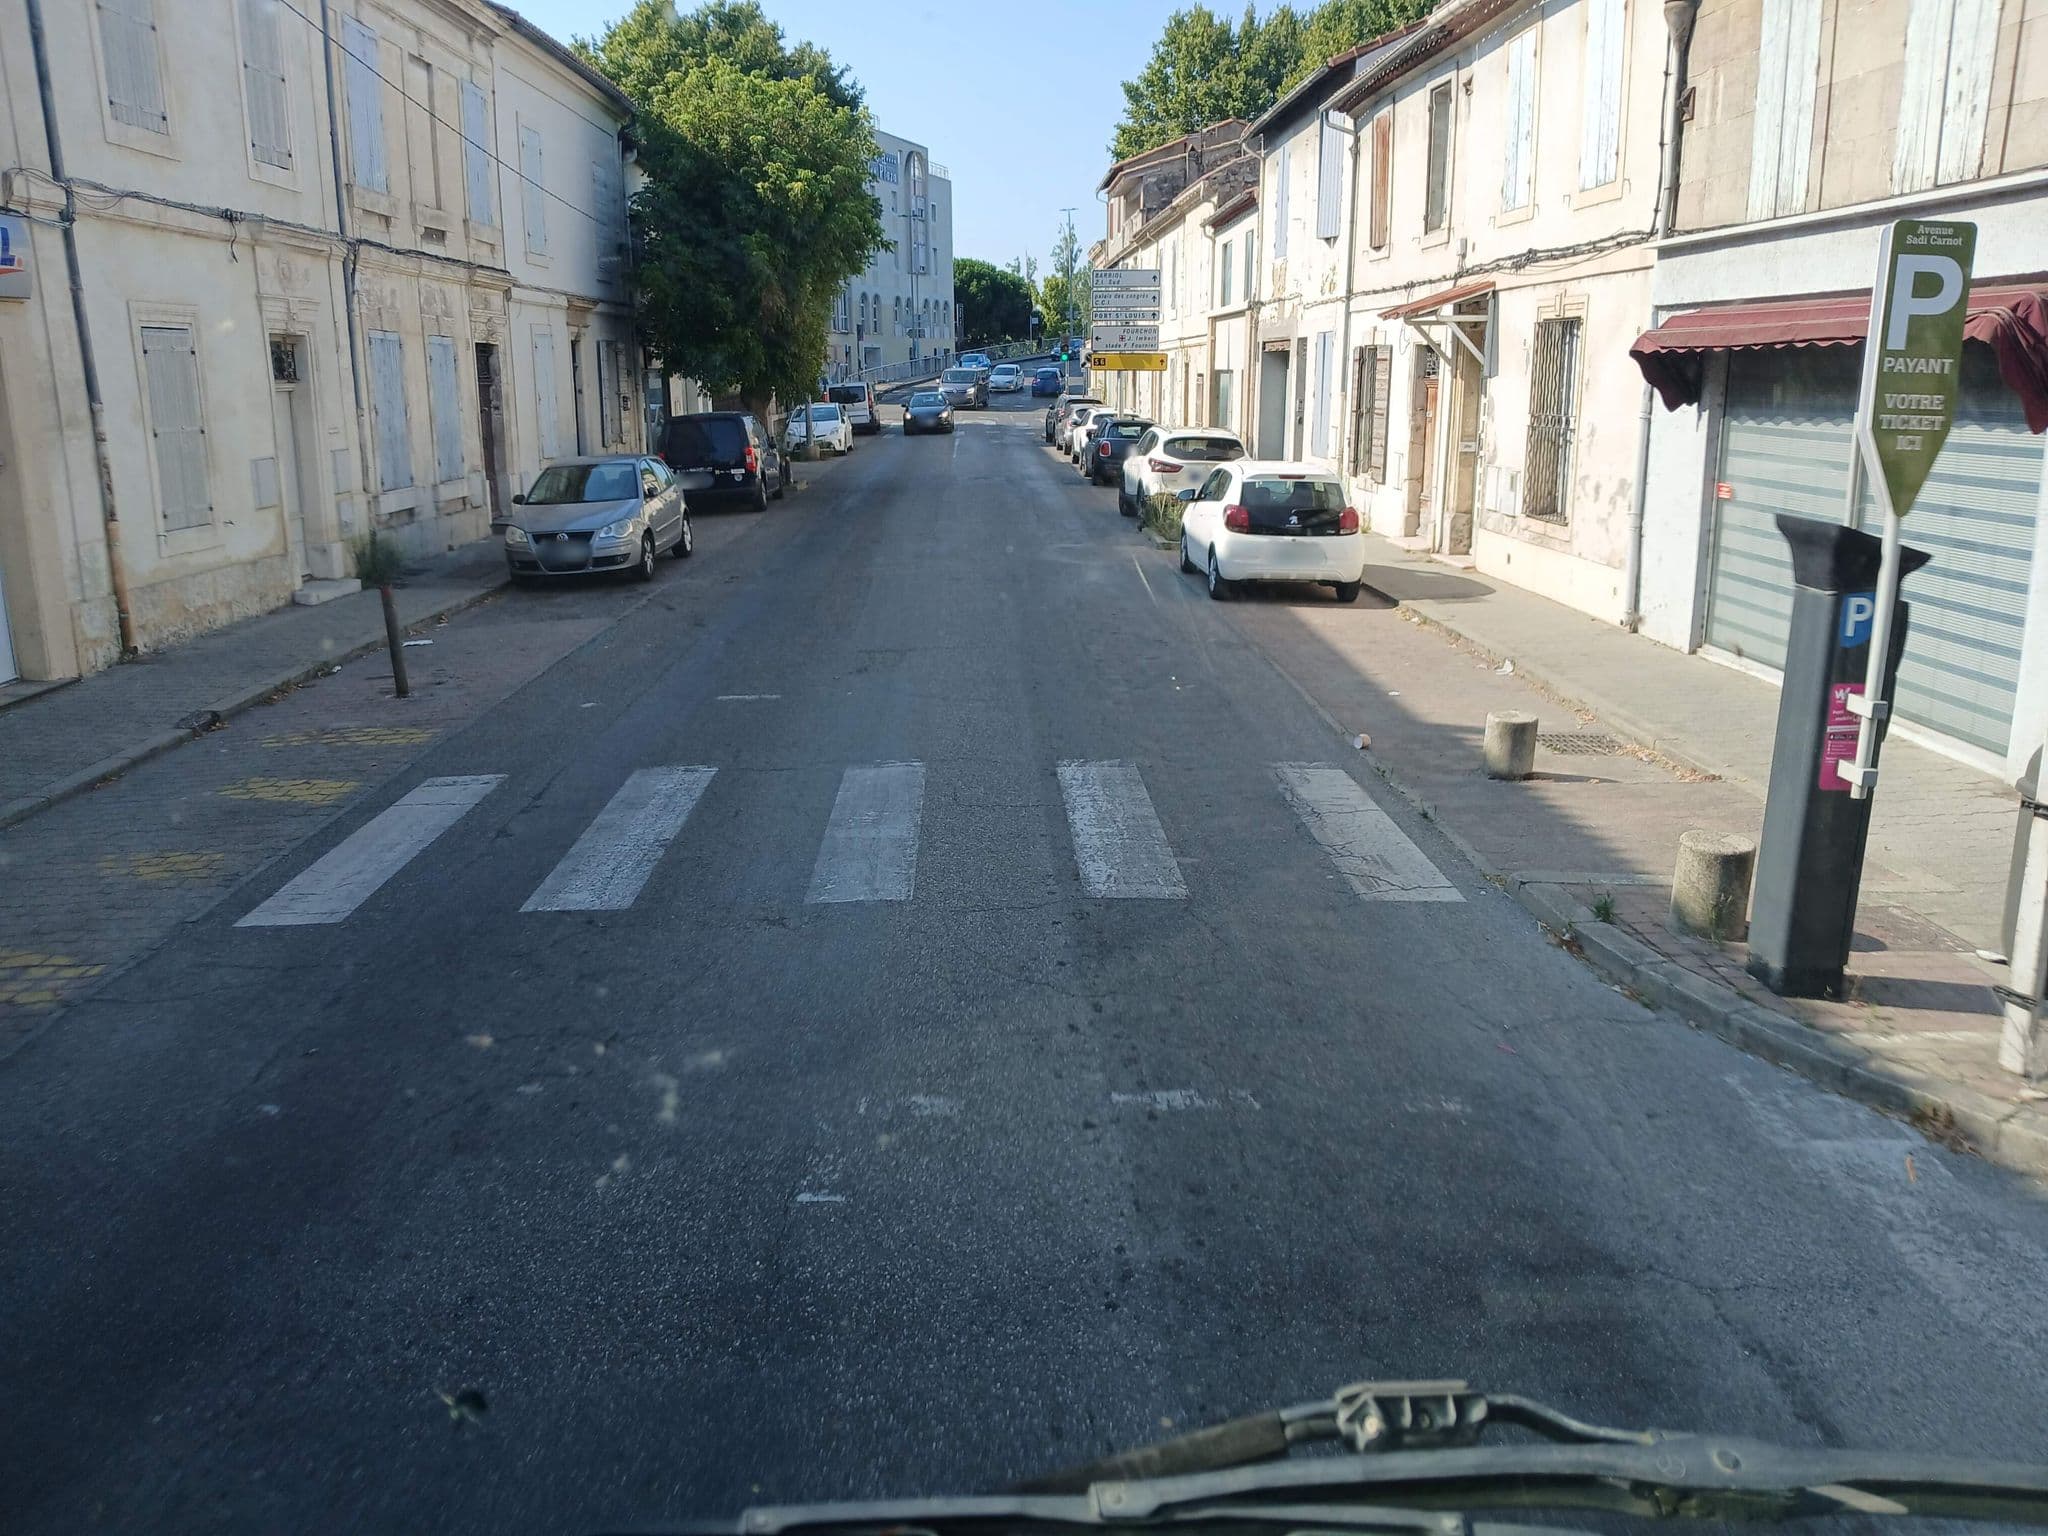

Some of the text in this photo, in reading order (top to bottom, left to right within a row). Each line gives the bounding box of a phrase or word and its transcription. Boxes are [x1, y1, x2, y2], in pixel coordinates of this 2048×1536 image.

[1917, 225, 1954, 235] Avenue
[1906, 235, 1962, 246] Sadi Carnot
[1886, 253, 1964, 351] P
[1883, 357, 1954, 374] PAYANT
[1884, 393, 1944, 410] VOTRE
[1880, 414, 1945, 430] TICKET
[1896, 435, 1923, 451] ICI
[1845, 597, 1874, 637] P
